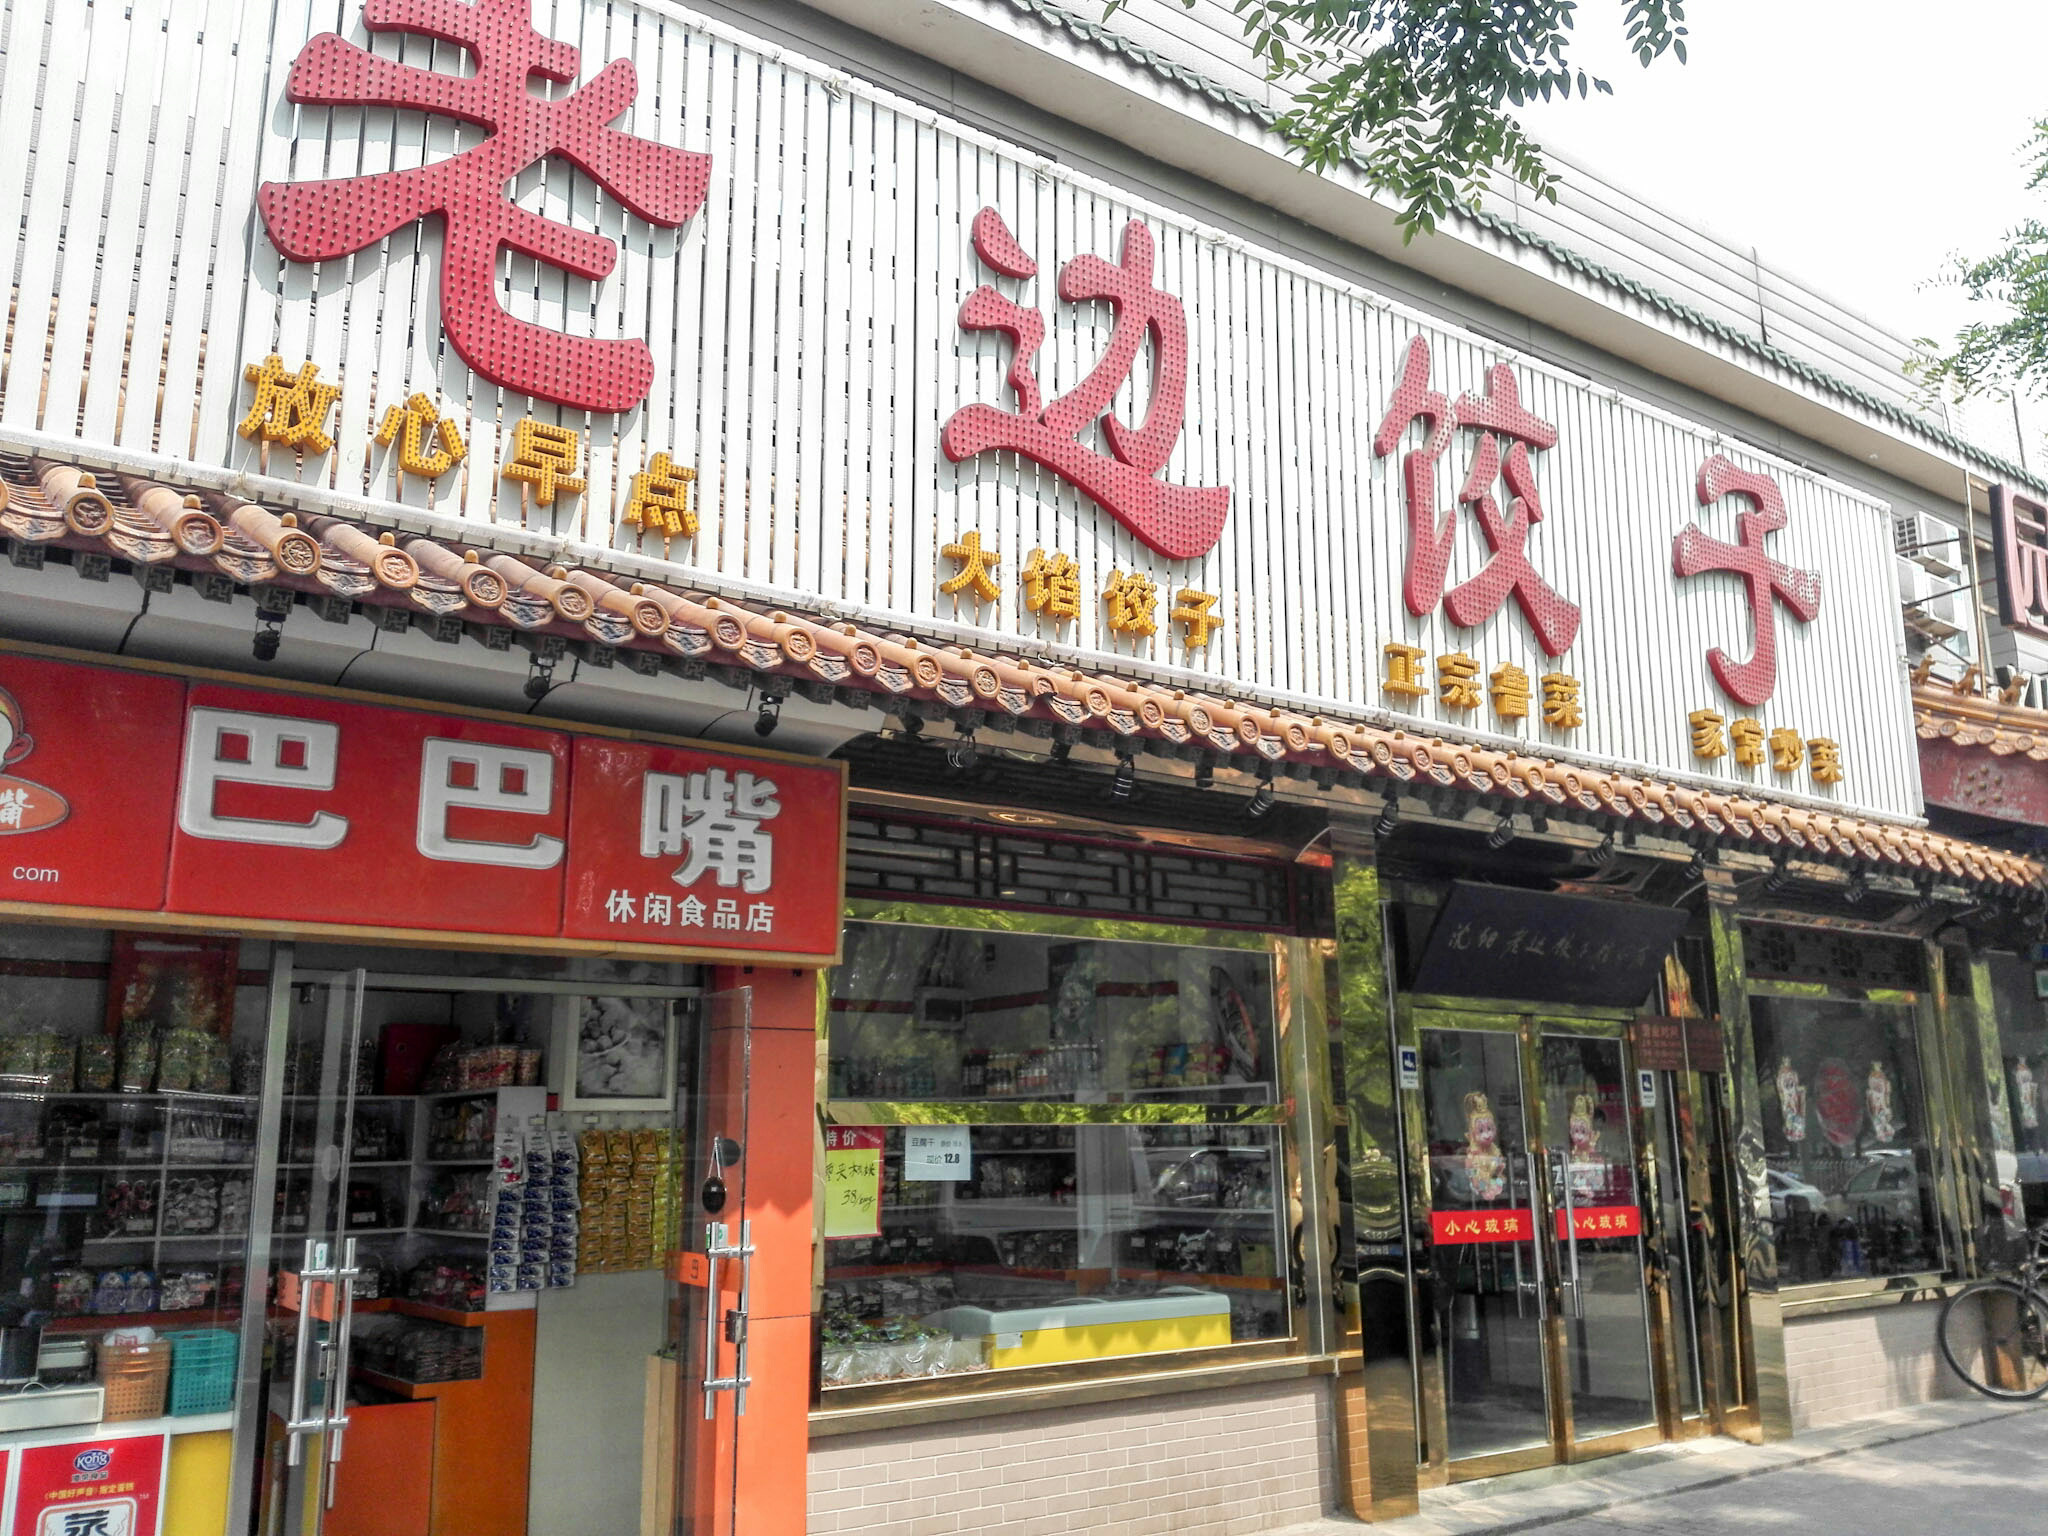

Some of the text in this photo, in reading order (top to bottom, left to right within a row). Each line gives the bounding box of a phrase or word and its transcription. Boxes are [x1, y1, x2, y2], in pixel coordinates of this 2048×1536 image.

[237, 354, 700, 539] 放心早点
[941, 531, 1225, 648] 大馅饺子
[1383, 642, 1584, 728] 正宗鲁菜
[1689, 708, 1845, 784] 家常炒菜
[178, 704, 782, 895] 巴巴嘴
[604, 889, 775, 933] 休闲食品店
[944, 1153, 960, 1164] 12.8
[1445, 1218, 1519, 1236] 小心玻璃
